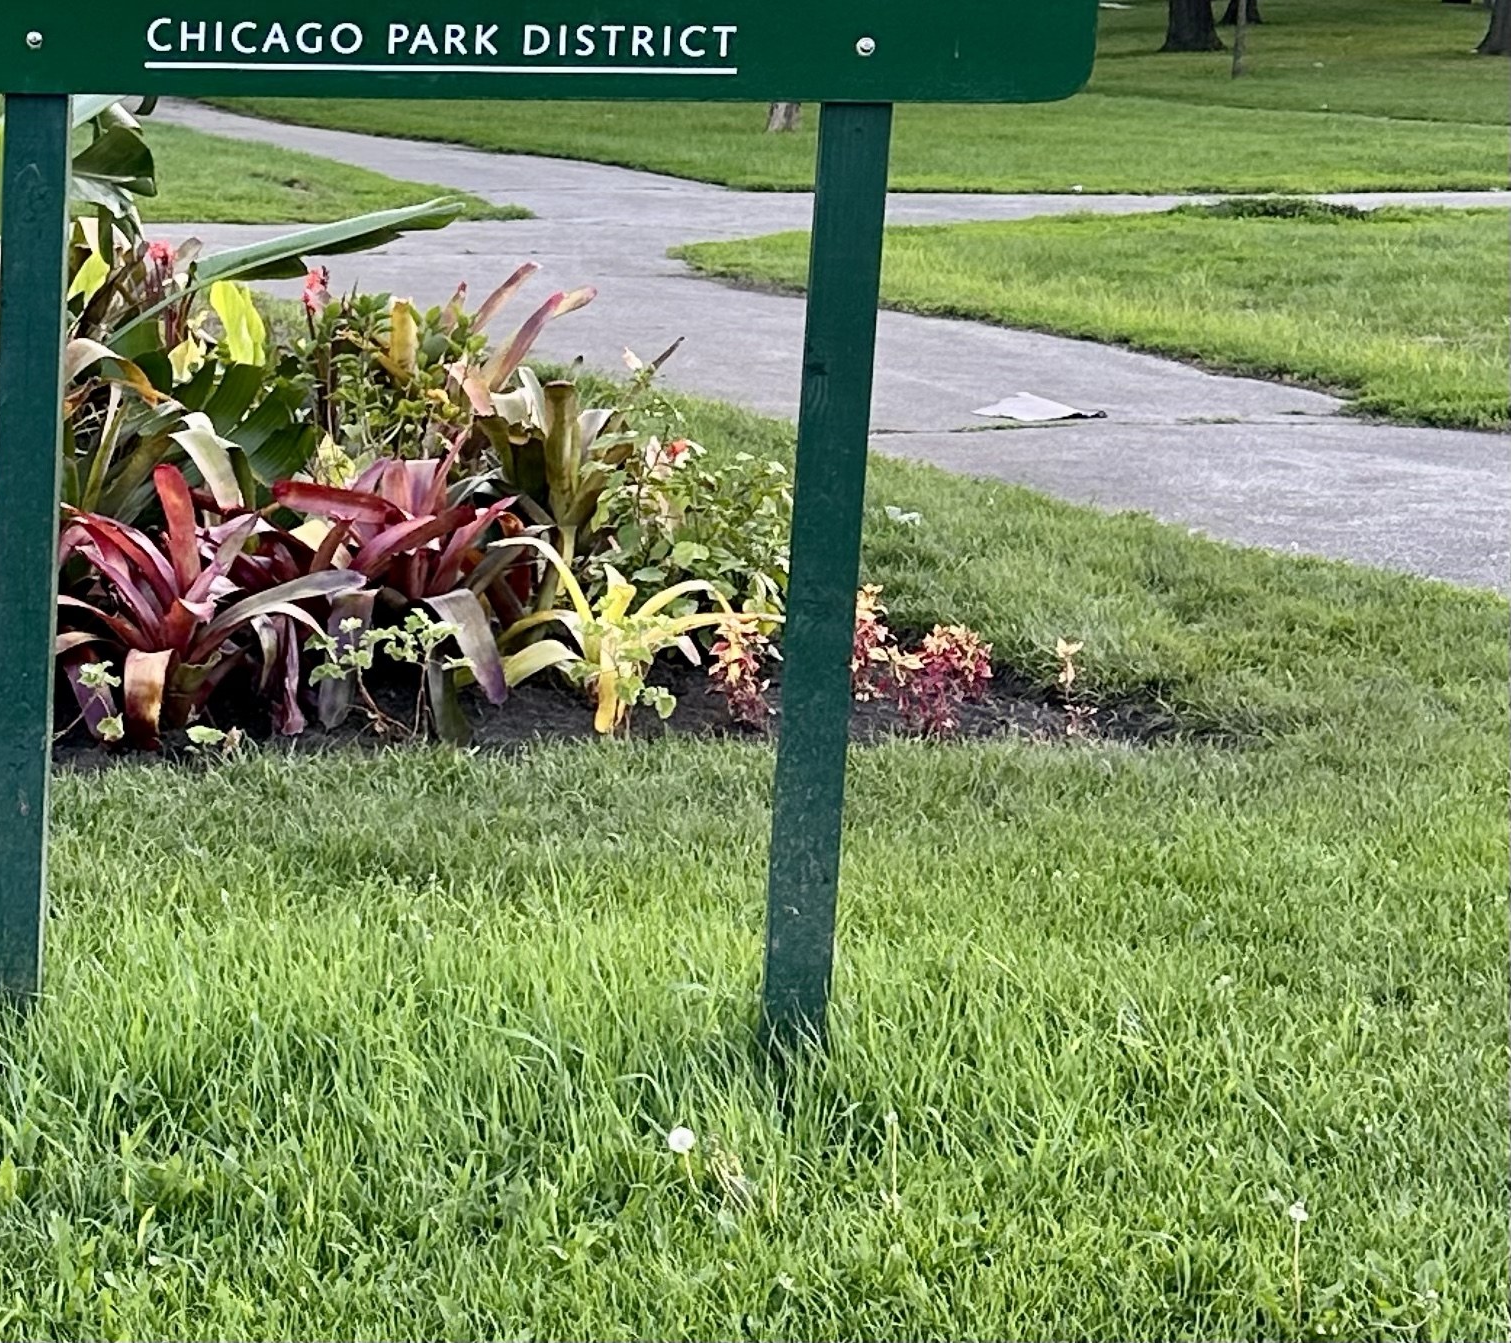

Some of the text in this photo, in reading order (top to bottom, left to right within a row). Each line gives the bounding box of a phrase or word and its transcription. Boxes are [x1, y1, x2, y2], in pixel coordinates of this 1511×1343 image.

[147, 17, 738, 58] CHICAGO PARK DISTRICT
